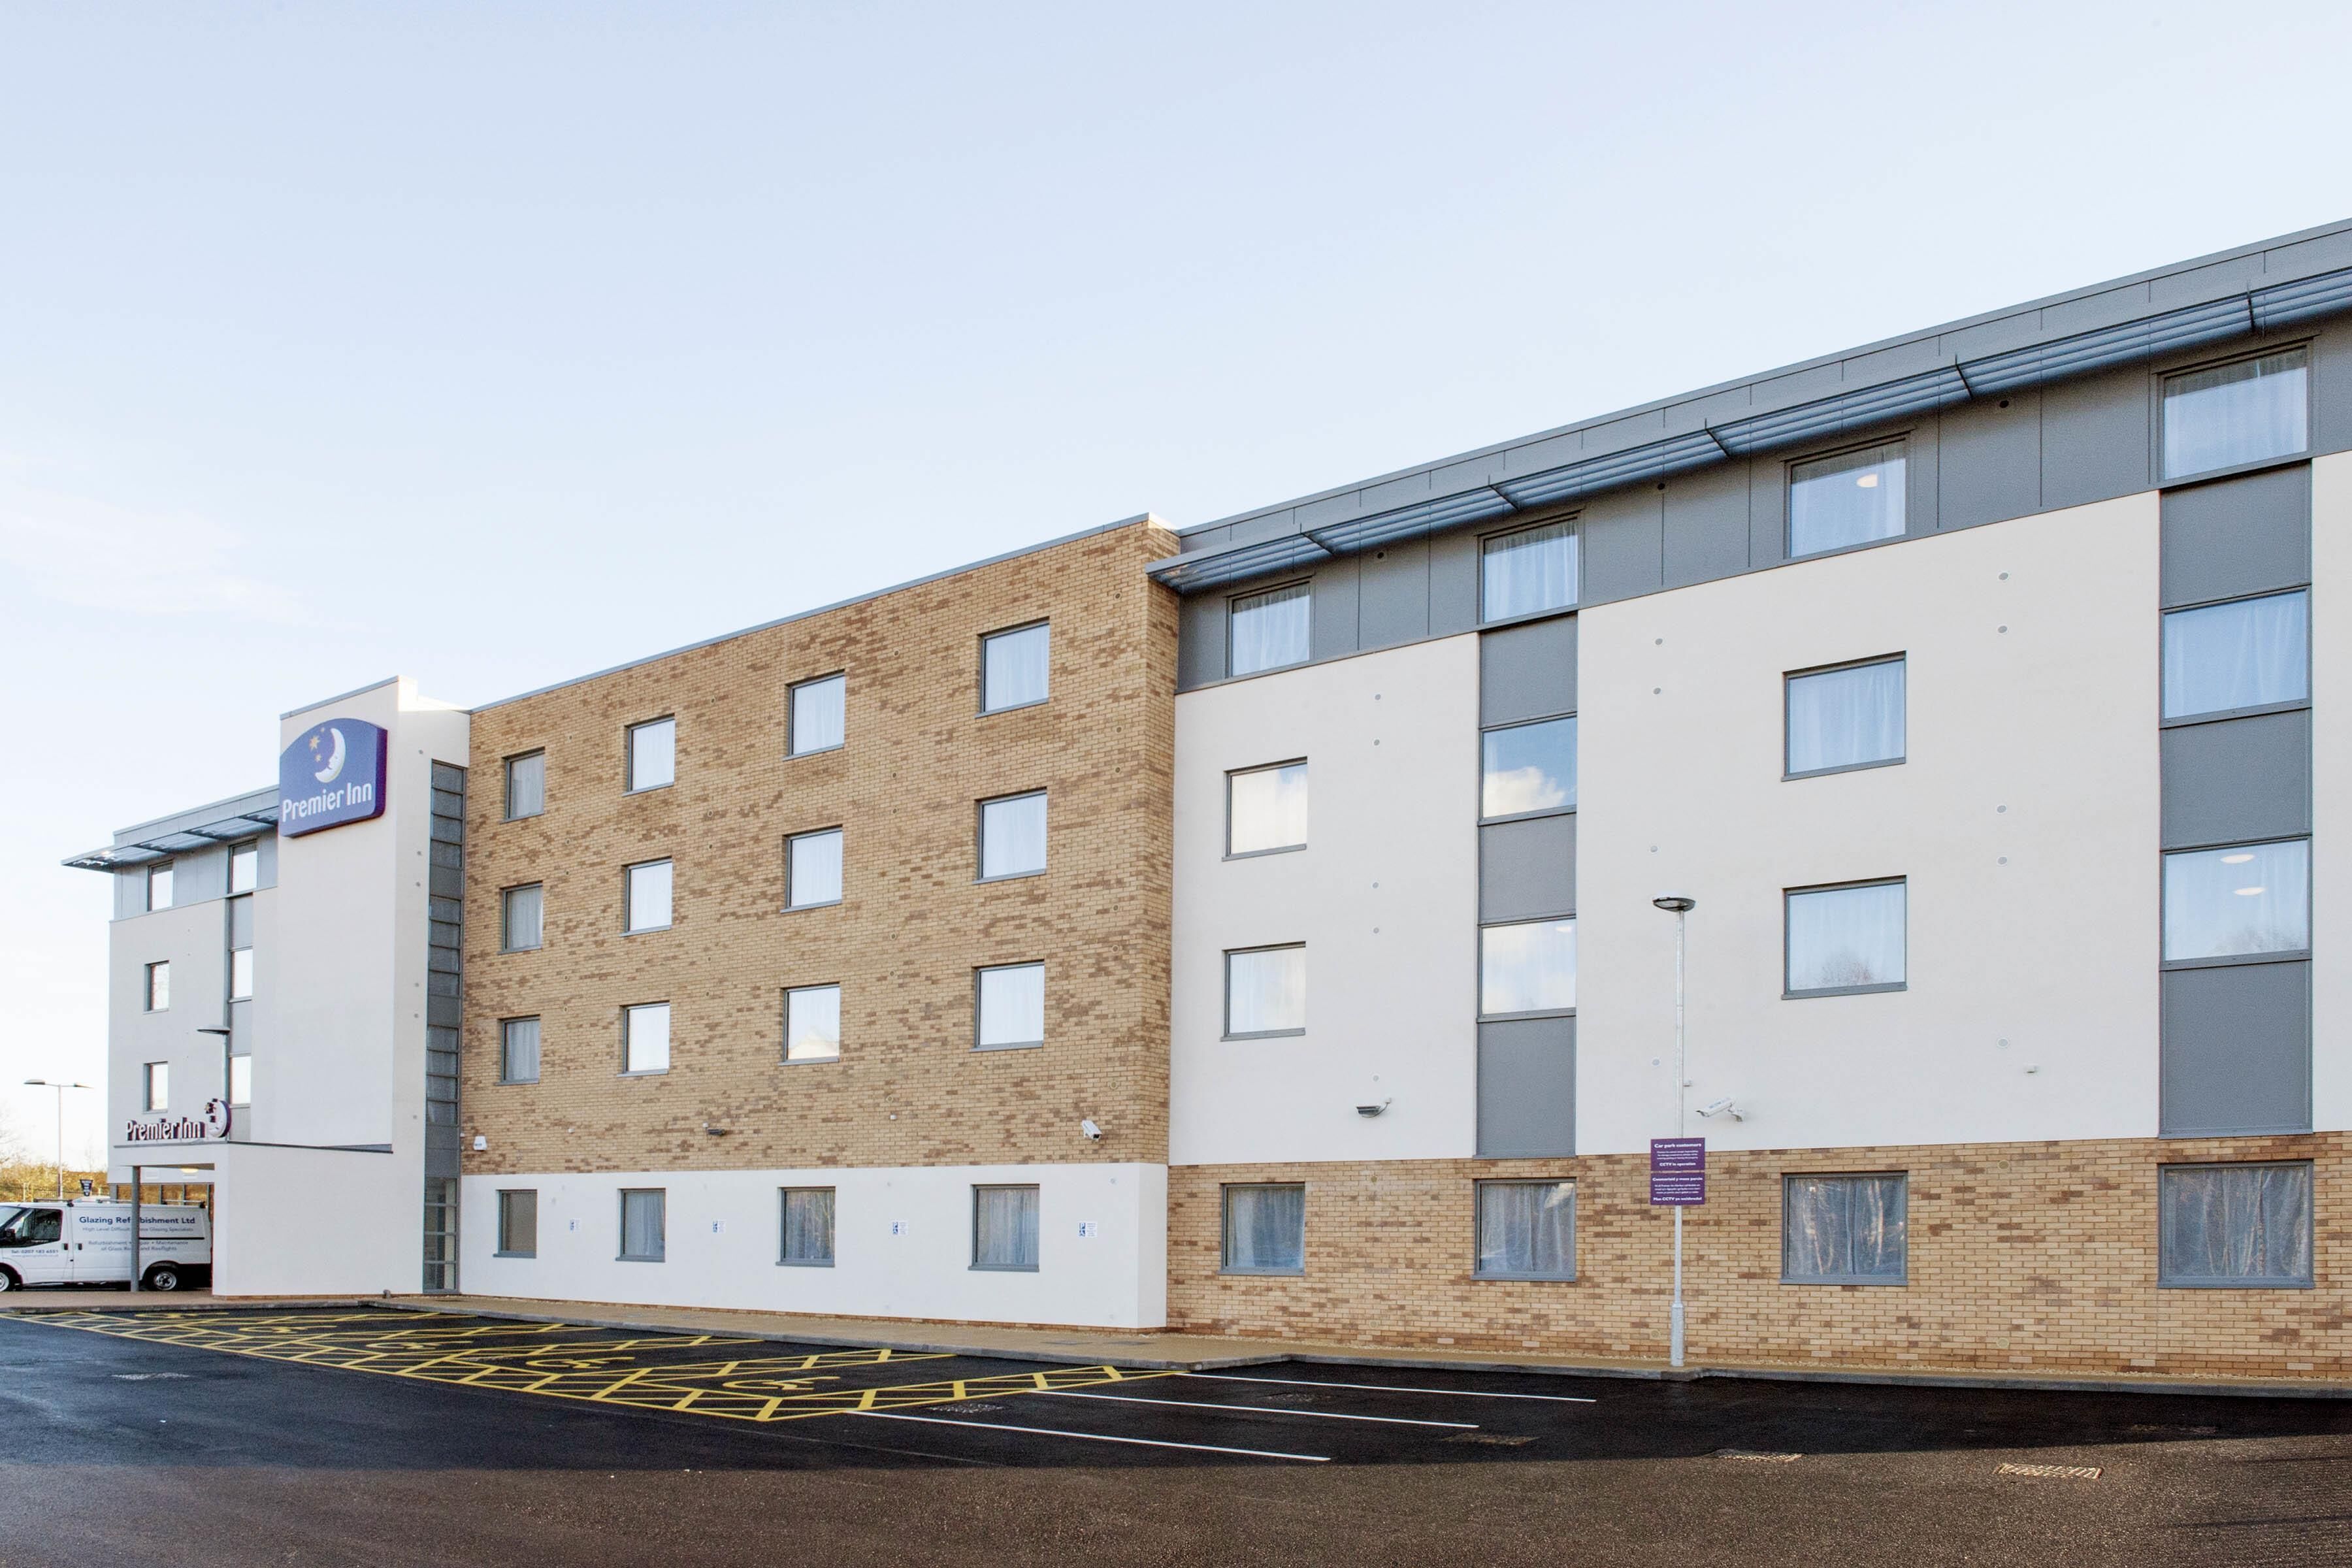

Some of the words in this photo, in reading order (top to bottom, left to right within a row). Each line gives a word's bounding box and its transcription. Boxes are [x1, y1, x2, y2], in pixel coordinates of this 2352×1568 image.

[283, 789, 344, 822] Premier
[346, 782, 372, 806] Inn
[125, 1118, 180, 1141] Premier
[180, 1117, 204, 1139] Inn
[79, 1217, 113, 1225] Glazing
